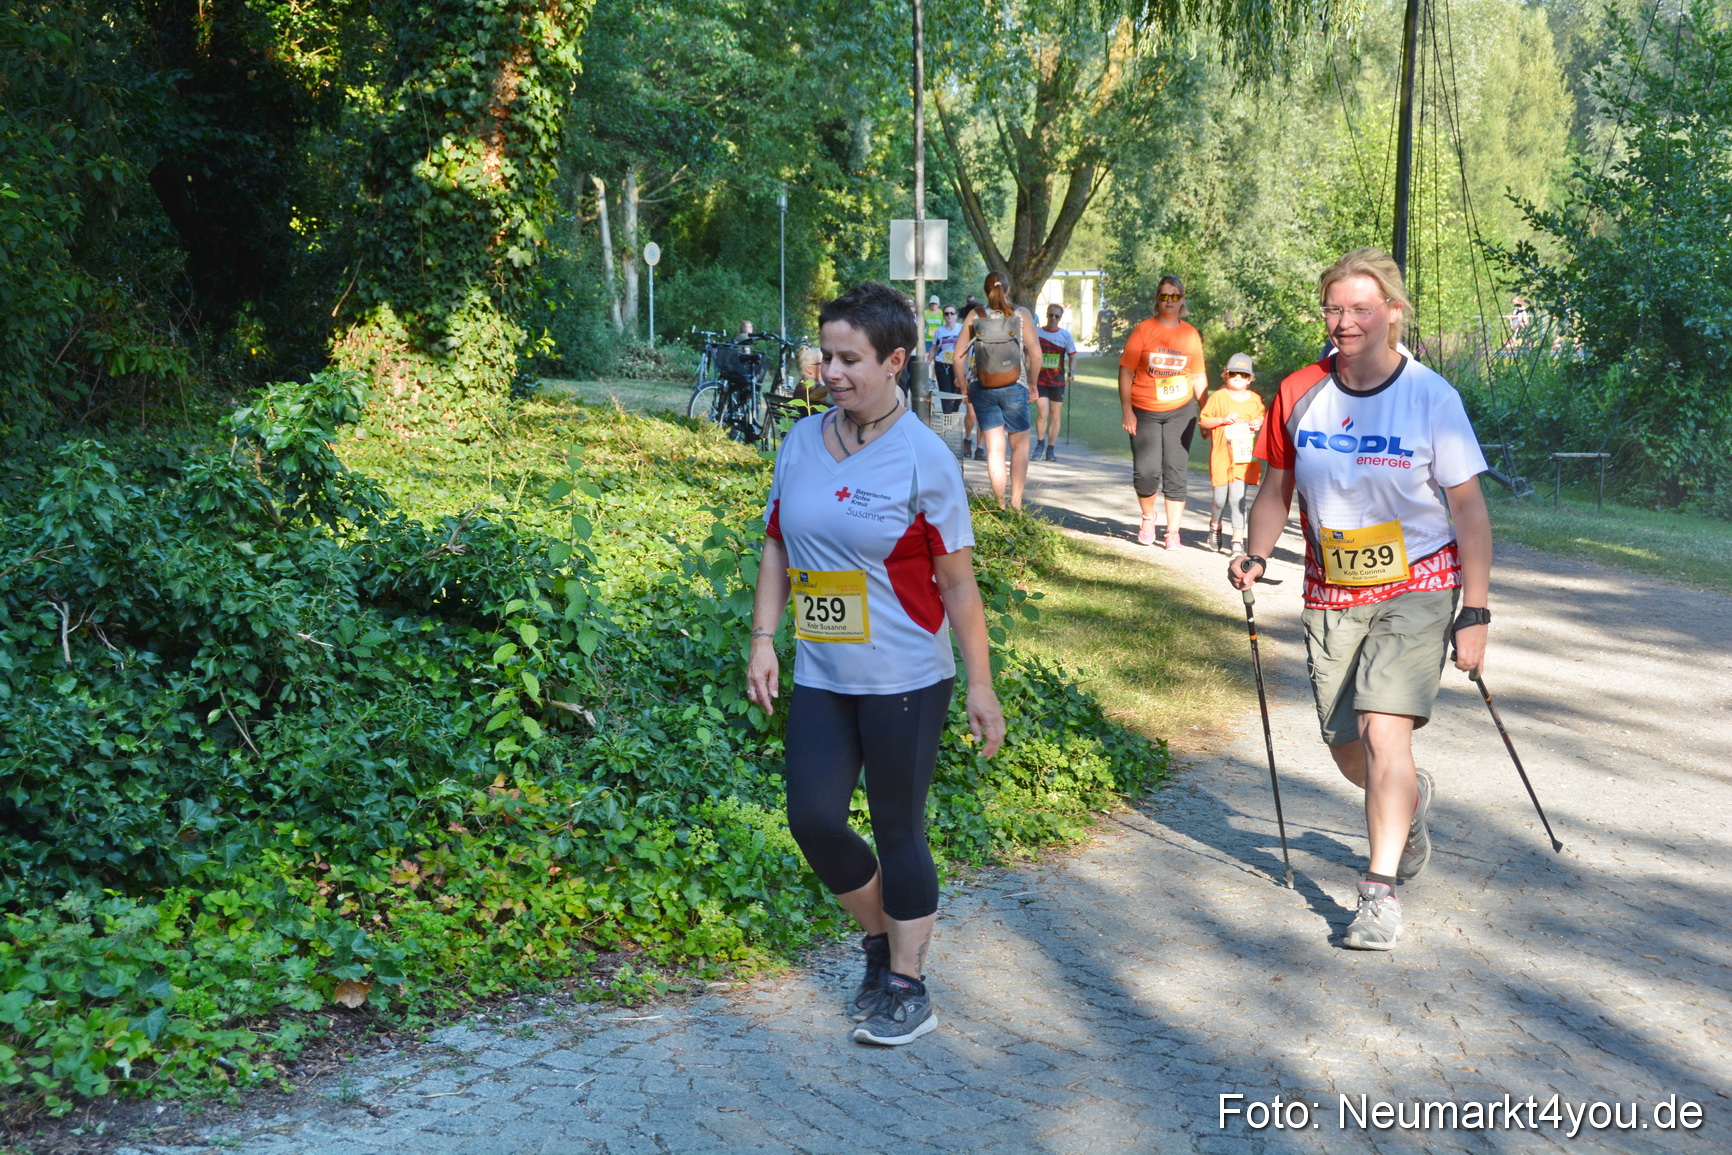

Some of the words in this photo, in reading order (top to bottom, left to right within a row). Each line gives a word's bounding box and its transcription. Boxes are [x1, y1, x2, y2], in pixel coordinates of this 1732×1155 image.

[1151, 355, 1185, 367] OBI
[1163, 385, 1180, 395] 891
[1356, 454, 1411, 470] energie
[853, 493, 871, 502] Rotes
[855, 488, 892, 500] Bayerisches
[850, 499, 868, 508] Kreuz
[845, 506, 885, 523] Susanne
[1331, 545, 1394, 570] 1739
[1359, 568, 1386, 576] Corinna
[1310, 584, 1354, 603] AVIA
[803, 595, 846, 623] 259
[820, 623, 847, 631] Susanne
